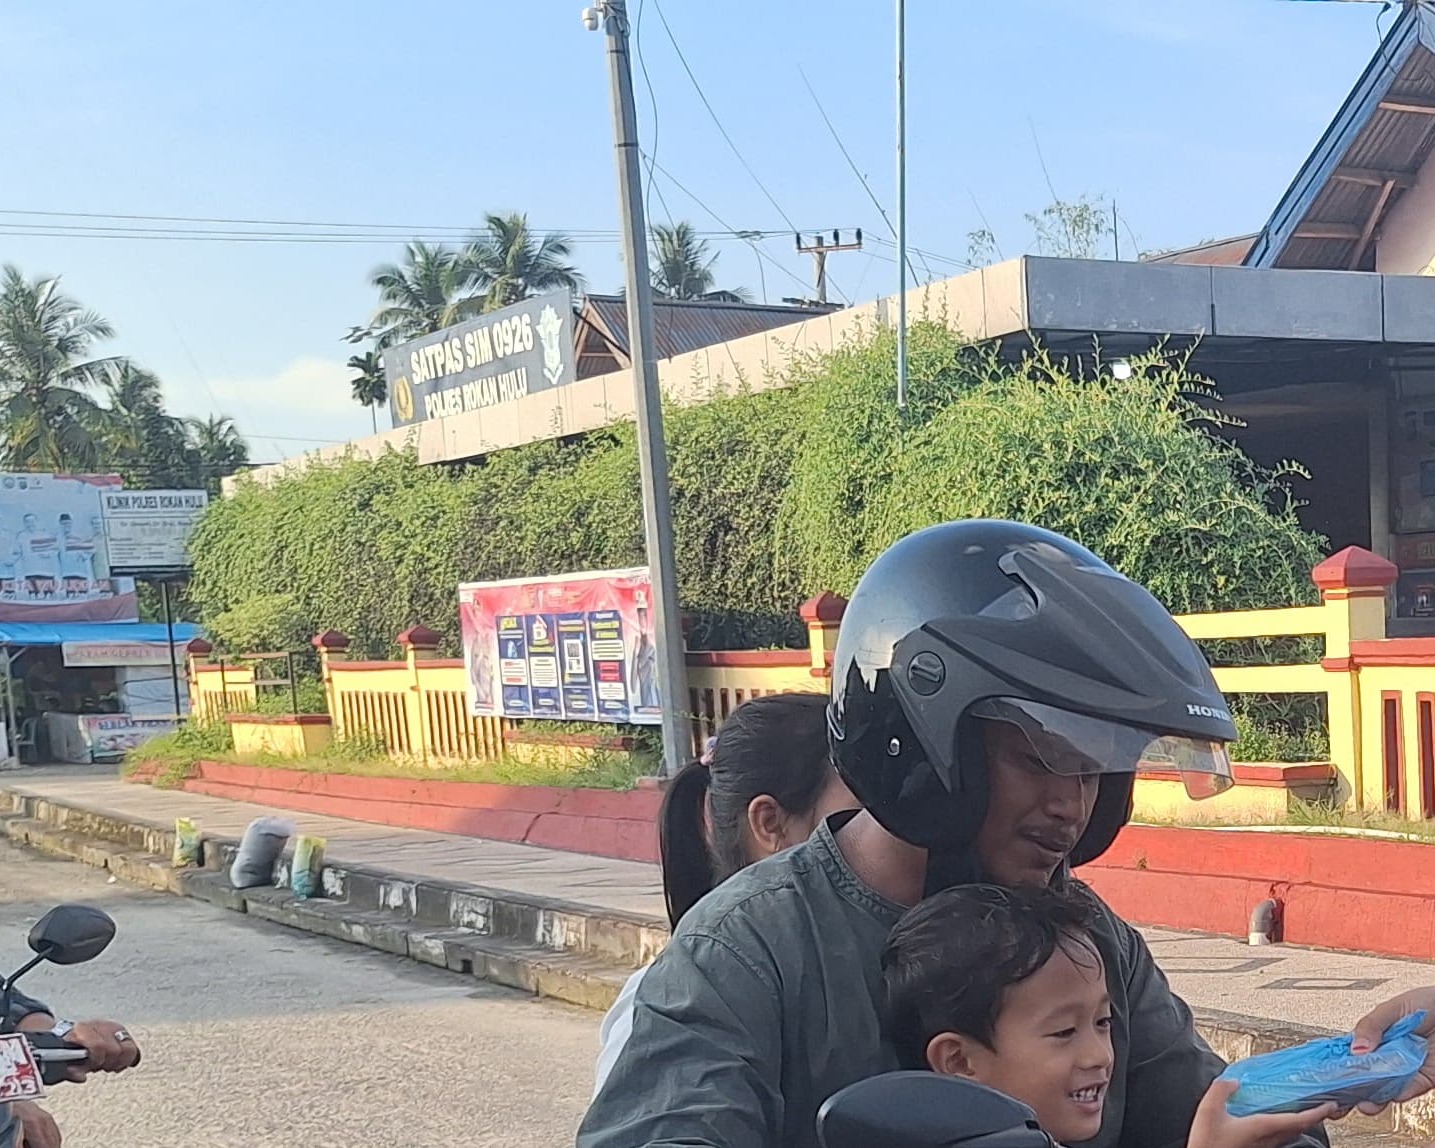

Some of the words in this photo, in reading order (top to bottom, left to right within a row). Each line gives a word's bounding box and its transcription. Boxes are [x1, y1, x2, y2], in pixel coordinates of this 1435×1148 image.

[411, 338, 464, 385] SATPAS
[464, 326, 493, 369] SIM
[493, 313, 534, 357] 0926
[424, 386, 462, 420] POLRES
[463, 376, 499, 412] ROKAN
[498, 367, 528, 402] HULU
